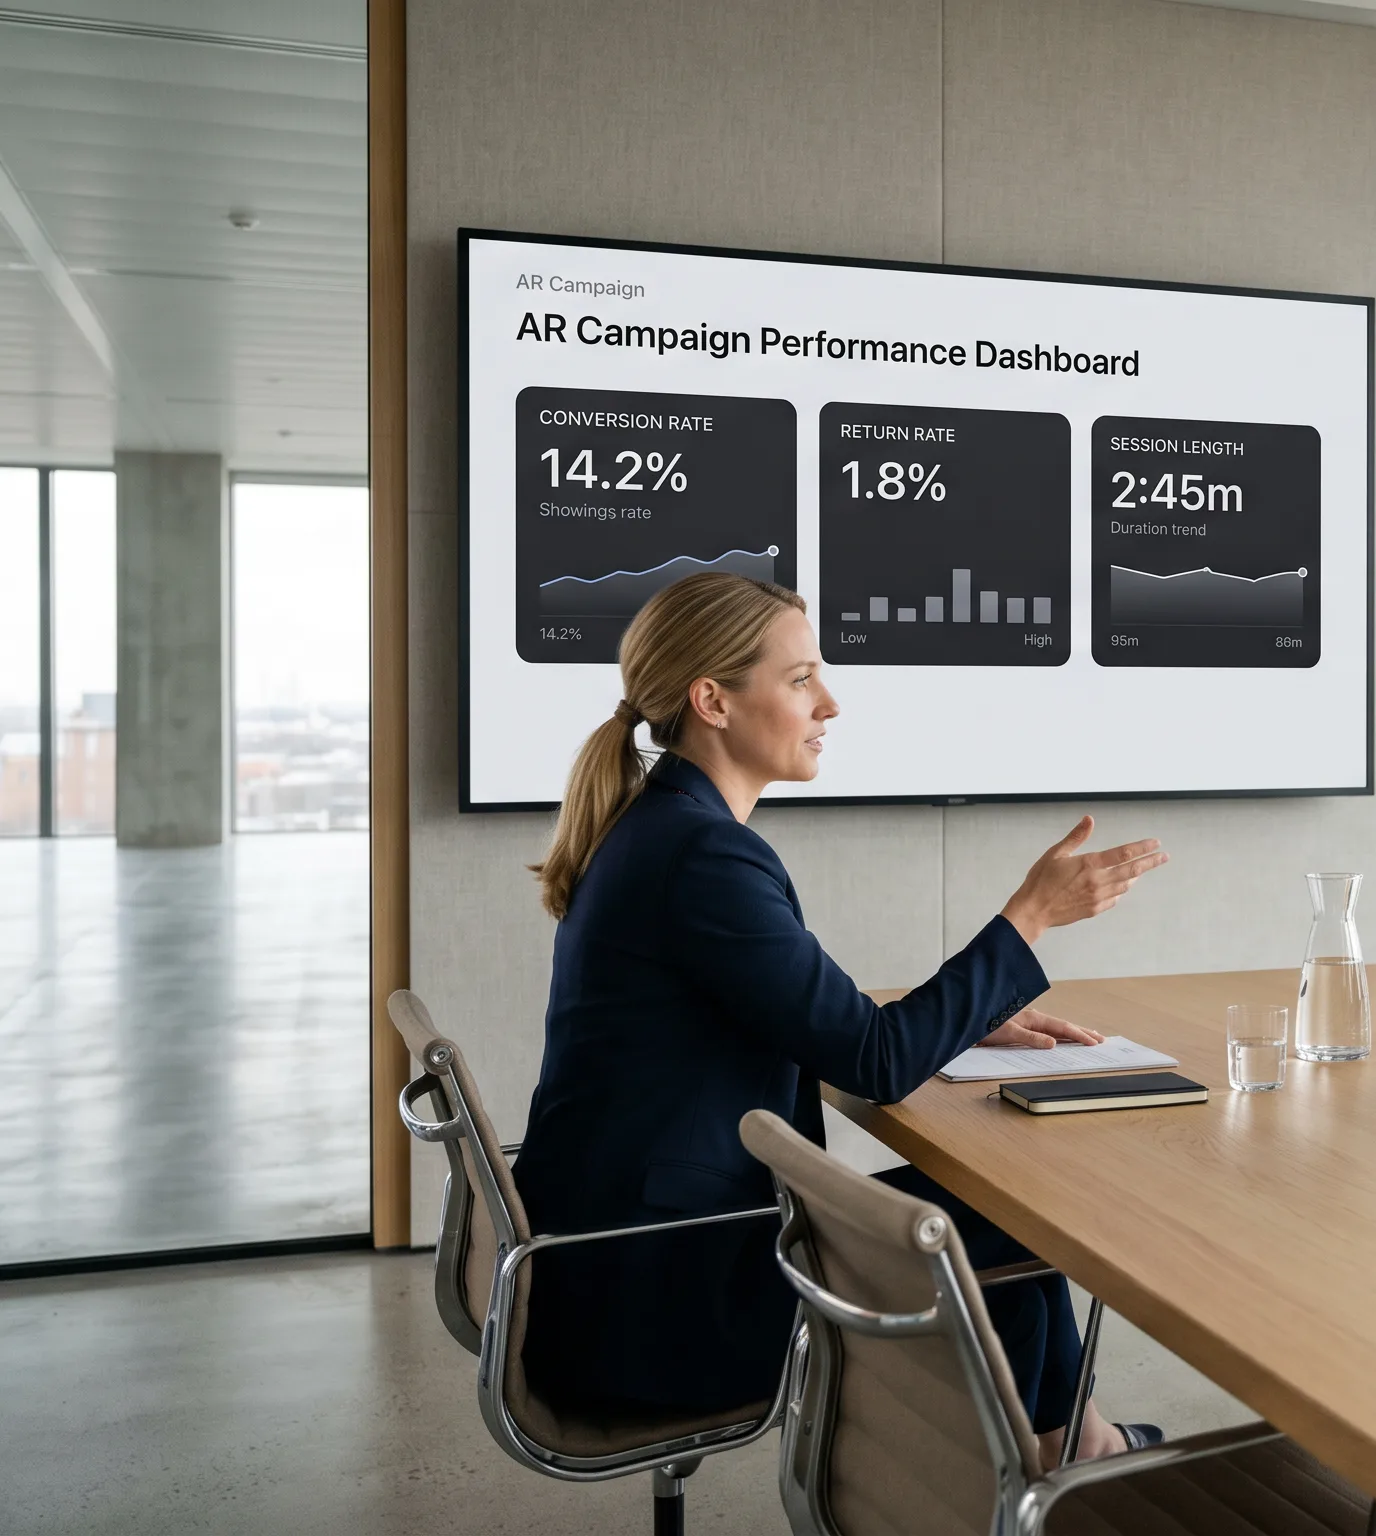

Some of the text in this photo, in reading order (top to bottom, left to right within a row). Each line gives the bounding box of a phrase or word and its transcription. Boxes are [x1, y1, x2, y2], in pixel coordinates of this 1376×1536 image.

[516, 274, 644, 299] AR Campaign
[516, 312, 1138, 376] AR Campaign Performance Dashboard
[540, 410, 712, 431] CONVERSION RATE
[841, 424, 955, 442] RETURN RATE
[1111, 437, 1243, 455] SESSION LENGTH
[541, 449, 687, 492] 14.2%
[843, 461, 945, 501] 1.8%
[1112, 471, 1242, 511] 2:45m
[540, 503, 651, 520] Showings rate
[1112, 521, 1206, 536] Duration trend
[540, 628, 581, 640] 14.2%
[841, 632, 866, 643] Low
[1025, 634, 1052, 648] High
[1111, 635, 1138, 646] 95m
[1276, 637, 1302, 647] 86m
